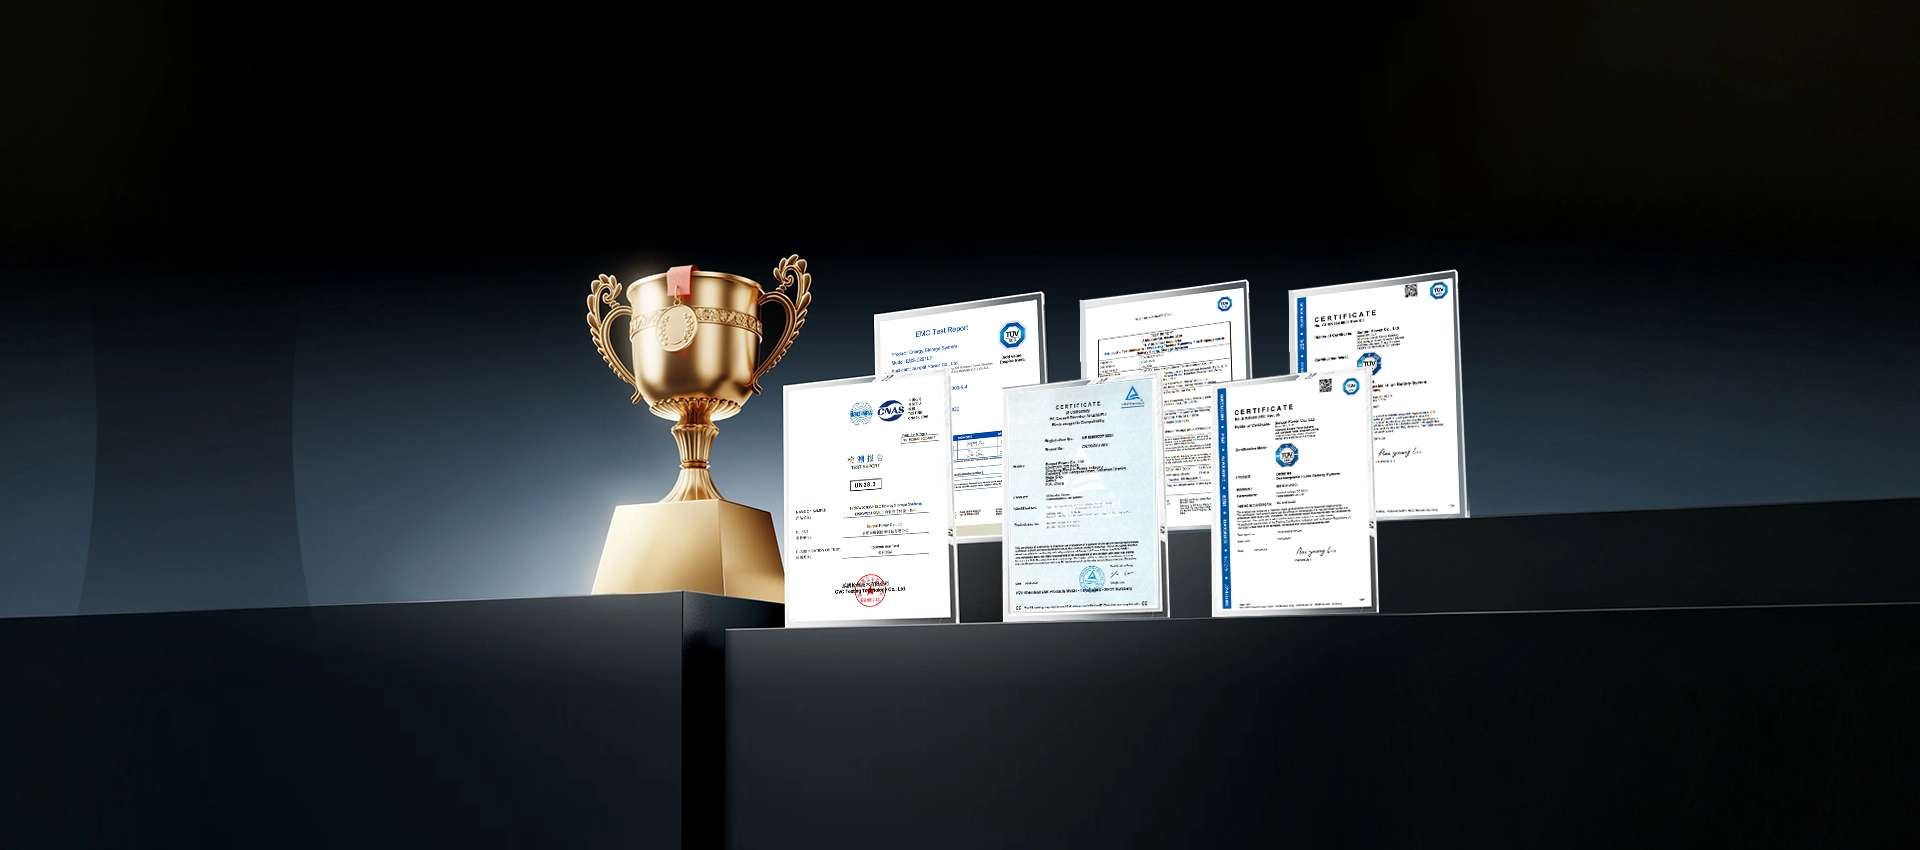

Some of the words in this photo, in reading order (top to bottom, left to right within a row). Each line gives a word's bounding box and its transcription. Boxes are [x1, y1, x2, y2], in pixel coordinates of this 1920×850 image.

[1314, 310, 1377, 322] CERTIFICATE
[933, 327, 946, 335] Test
[948, 325, 968, 334] Report
[877, 406, 904, 415] CNAS
[1056, 401, 1101, 410] CERTIFICATE
[1234, 404, 1294, 416] CERTIFICATE
